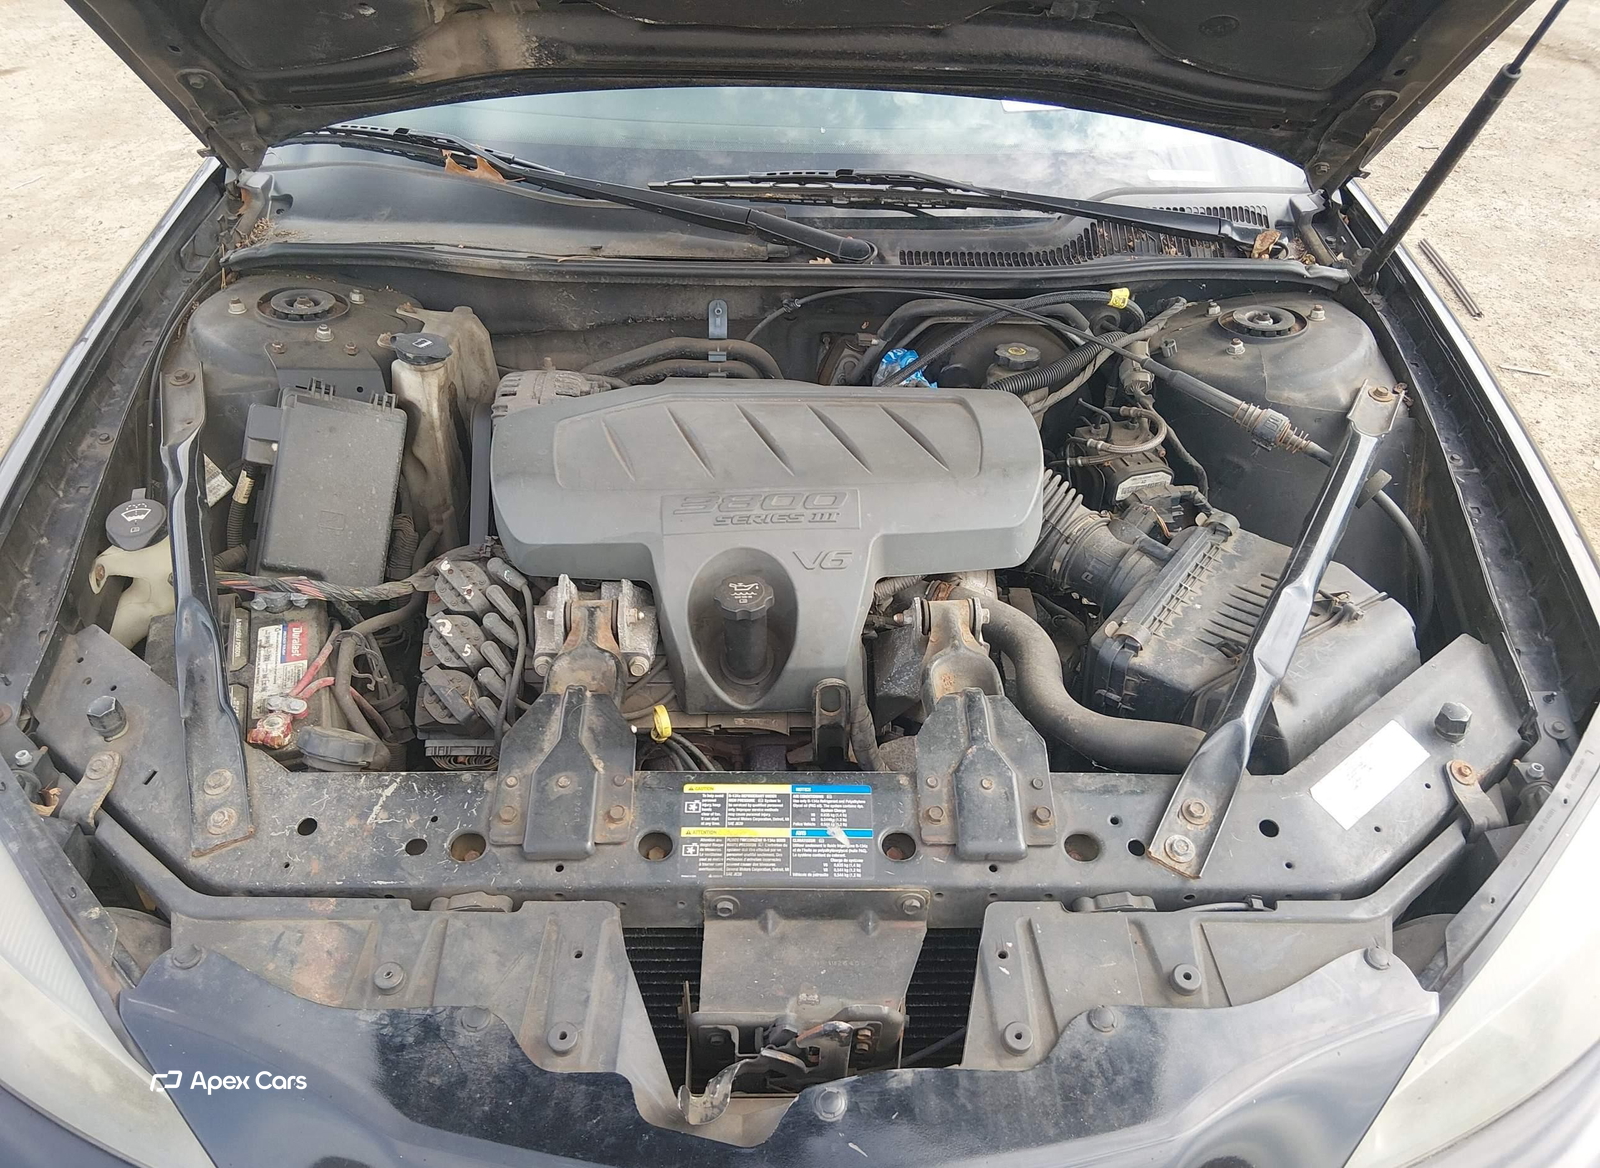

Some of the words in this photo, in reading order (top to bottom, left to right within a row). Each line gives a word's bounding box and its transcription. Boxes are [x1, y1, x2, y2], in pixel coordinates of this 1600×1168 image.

[672, 491, 849, 515] 3800
[713, 513, 805, 526] SERIES
[808, 512, 840, 524] III
[792, 550, 852, 570] V6
[291, 626, 303, 657] Duralast
[461, 643, 472, 657] 5
